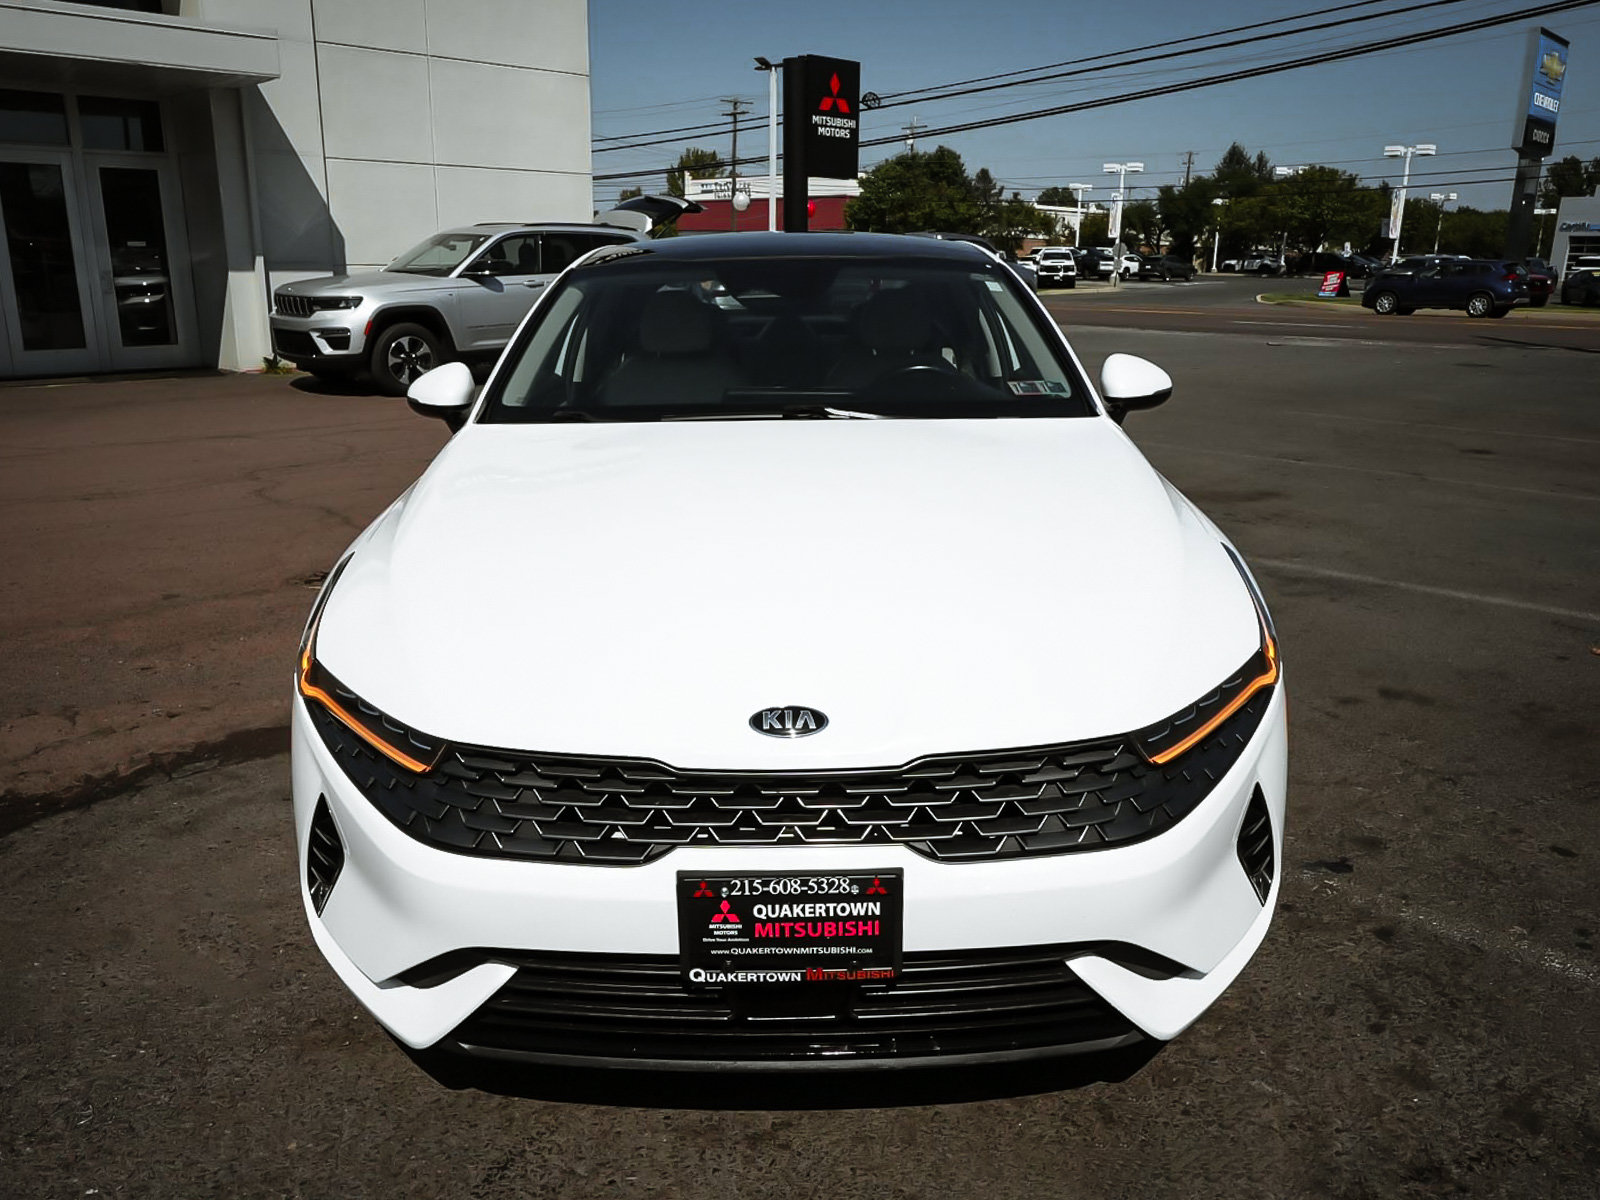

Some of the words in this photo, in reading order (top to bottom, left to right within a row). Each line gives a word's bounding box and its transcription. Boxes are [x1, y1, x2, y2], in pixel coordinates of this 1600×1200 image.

[812, 115, 856, 128] MITSUBISHI
[818, 126, 850, 138] MOTORS
[762, 710, 817, 730] KIA
[731, 878, 850, 895] 215-608-5328
[753, 903, 880, 919] QUAKERTOWN
[754, 921, 879, 937] MITSUBISHI
